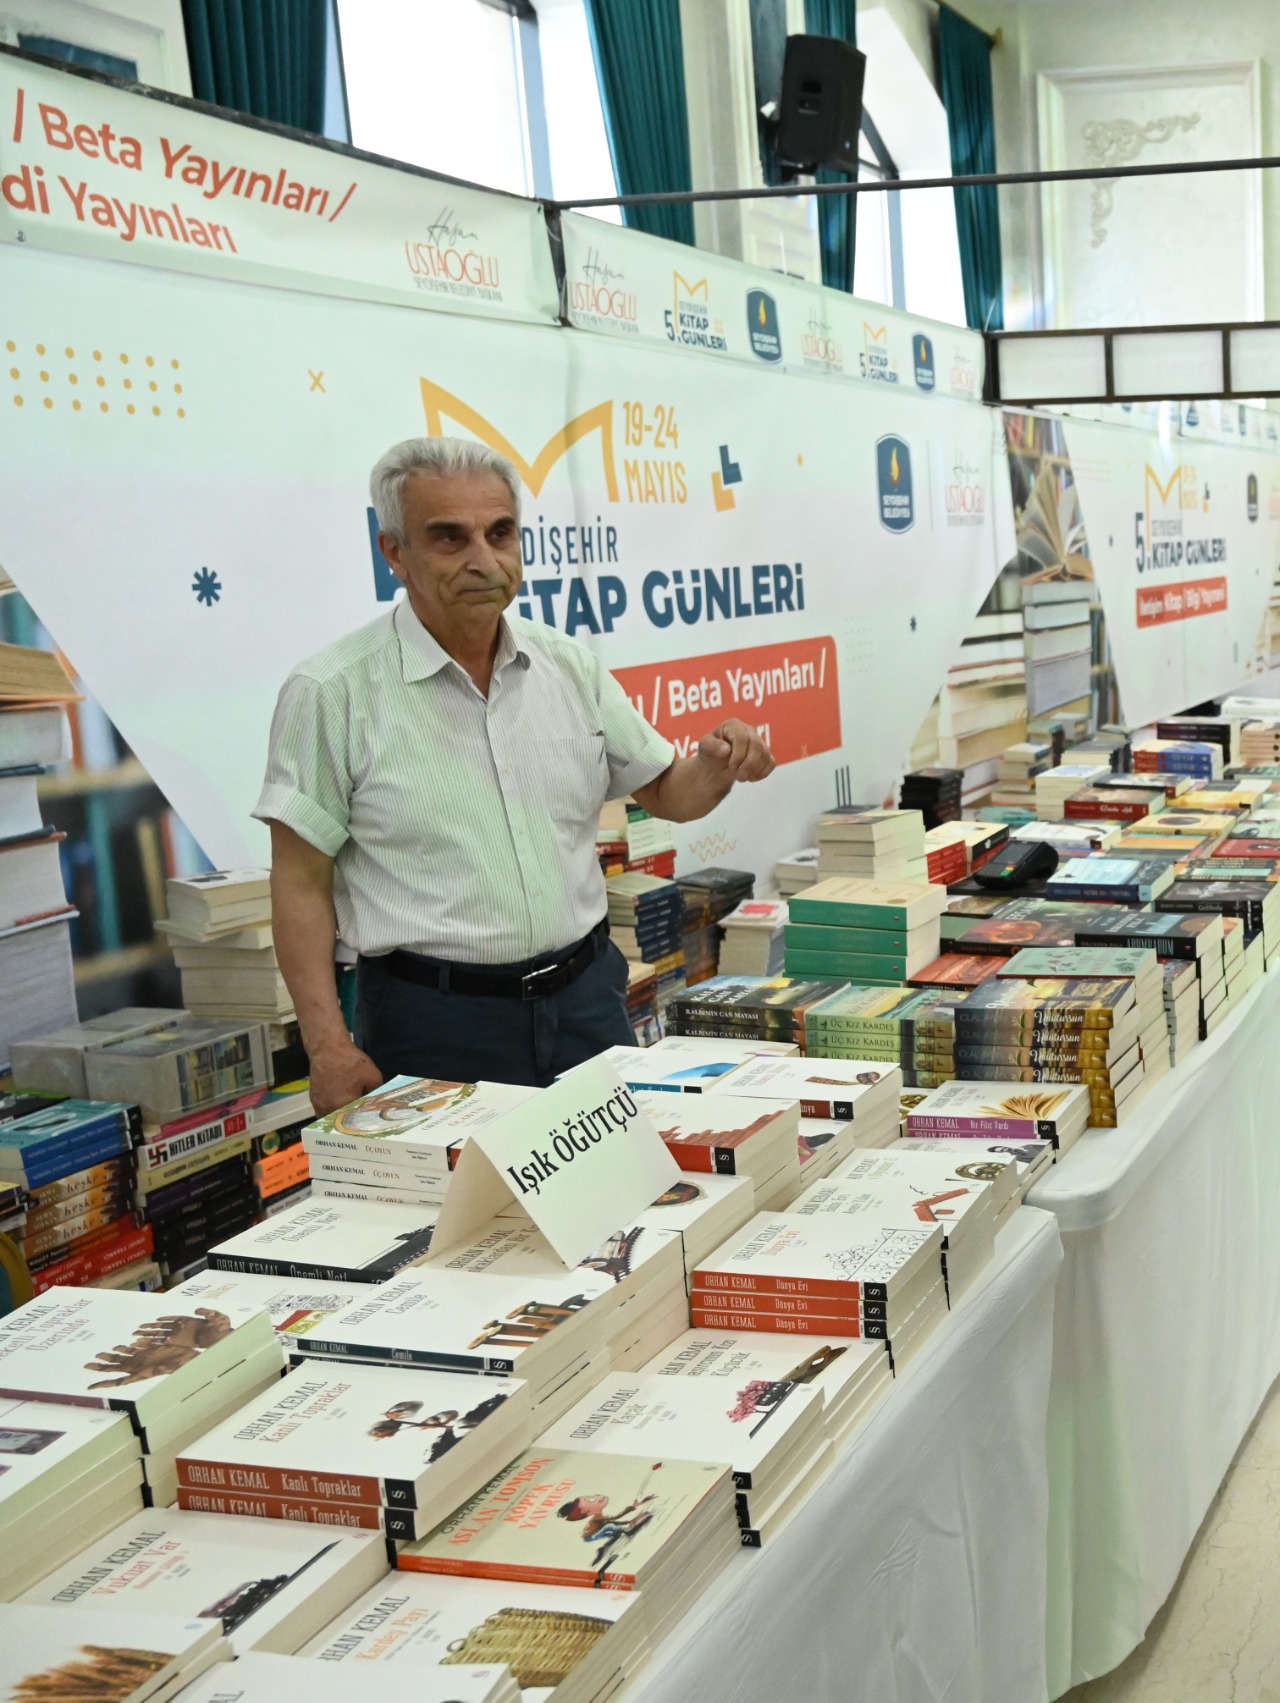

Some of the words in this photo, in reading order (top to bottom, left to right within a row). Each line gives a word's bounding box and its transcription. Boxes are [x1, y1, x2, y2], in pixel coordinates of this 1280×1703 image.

[38, 103, 142, 171] Beta
[58, 175, 238, 253] Yayınları
[405, 241, 499, 288] USTAOĞLU
[568, 282, 637, 321] USTAOĞLU
[680, 313, 709, 330] KİTAP
[682, 330, 728, 351] GÜNLERİ
[623, 400, 679, 449] 19-24
[624, 459, 688, 504] MAYIS
[522, 515, 619, 575] DİŞEHİR
[1152, 541, 1183, 570] KİTAP
[1186, 538, 1227, 567] GÜNLERİ
[520, 574, 627, 638] İTAP
[642, 562, 805, 629] GÜNLERİ
[668, 679, 722, 717] Beta
[726, 658, 816, 708] Yayınları
[734, 1012, 759, 1020] MAYASI
[831, 1018, 843, 1030] ÜÇ
[846, 1019, 861, 1029] KIZ
[865, 1020, 895, 1032] KARDEŞ
[831, 1035, 843, 1047] ÜÇ
[846, 1036, 861, 1046] KIZ
[865, 1037, 895, 1049] KARDEŞ
[799, 1103, 816, 1115] ünya
[912, 1117, 934, 1128] ORHAN
[936, 1118, 960, 1129] KEMAL
[168, 1134, 196, 1157] HİTLER
[196, 1123, 223, 1148] KİTABI
[315, 1139, 336, 1148] ORHAN
[337, 1141, 358, 1151] KEMAL
[506, 1149, 560, 1195] Işık
[548, 1085, 639, 1163] ÖĞÜTÇÜ
[322, 1164, 343, 1173] ORHAN
[344, 1166, 366, 1175] KEMAL
[324, 1190, 346, 1199] ORHAN
[347, 1192, 368, 1201] KEMAL
[797, 1198, 820, 1215] HAN
[254, 1223, 296, 1244] ORHAN
[294, 1207, 333, 1225] KEMAL
[476, 1228, 516, 1251] KEMAL
[732, 1240, 760, 1261] ORHAN
[754, 1224, 788, 1244] KEMAL
[217, 1258, 246, 1272] ORHAN
[705, 1274, 729, 1288] ORHAN
[731, 1276, 757, 1290] KEMAL
[776, 1278, 796, 1292] Dünya
[797, 1281, 809, 1291] Evi
[2, 1304, 61, 1332] KEMAL
[26, 1298, 94, 1333] Topraklar
[339, 1300, 385, 1325] ORHAN
[383, 1281, 423, 1303] KEMAL
[385, 1293, 429, 1315] Cemile
[704, 1294, 728, 1308] ORHAN
[730, 1296, 756, 1310] KEMAL
[775, 1298, 795, 1312] Dünya
[796, 1301, 808, 1311] Evi
[25, 1317, 91, 1352] Üzerinde
[705, 1314, 729, 1328] ORHAN
[731, 1316, 757, 1330] KEMAL
[776, 1318, 796, 1332] Dünya
[797, 1320, 809, 1330] Evi
[309, 1341, 328, 1352] ORHAN
[329, 1343, 349, 1354] KEMAL
[391, 1348, 413, 1361] Cemile
[658, 1358, 688, 1376] HAN
[682, 1340, 713, 1361] KEMAL
[710, 1350, 751, 1377] Küçücük
[233, 1411, 287, 1441] ORHAN
[274, 1381, 329, 1411] KEMAL
[258, 1420, 303, 1444] Kanlı
[291, 1382, 352, 1420] Topraklar
[569, 1412, 610, 1440] ORHAN
[603, 1387, 640, 1414] KEMAL
[610, 1402, 649, 1426] Kaçak
[187, 1465, 226, 1485] ORHAN
[229, 1469, 270, 1490] KEMAL
[281, 1473, 309, 1492] Kanlı
[310, 1475, 362, 1498] Topraklar
[441, 1495, 486, 1535] ORHAN
[483, 1463, 522, 1497] KEMAL
[188, 1495, 226, 1514] ORHAN
[229, 1498, 268, 1518] KEMAL
[281, 1503, 309, 1521] Kanlı
[310, 1507, 361, 1527] Topraklar
[448, 1506, 501, 1547] ASLAN
[491, 1456, 555, 1504] TOMSON
[503, 1482, 556, 1523] KÖPEK
[518, 1478, 577, 1530] YAVRUSU
[51, 1566, 115, 1602] ORHAN
[102, 1530, 167, 1566] KEMAL
[91, 1559, 155, 1595] Vukuat
[143, 1540, 183, 1557] Var
[317, 1634, 366, 1662] HAN
[353, 1595, 411, 1632] KEMAL
